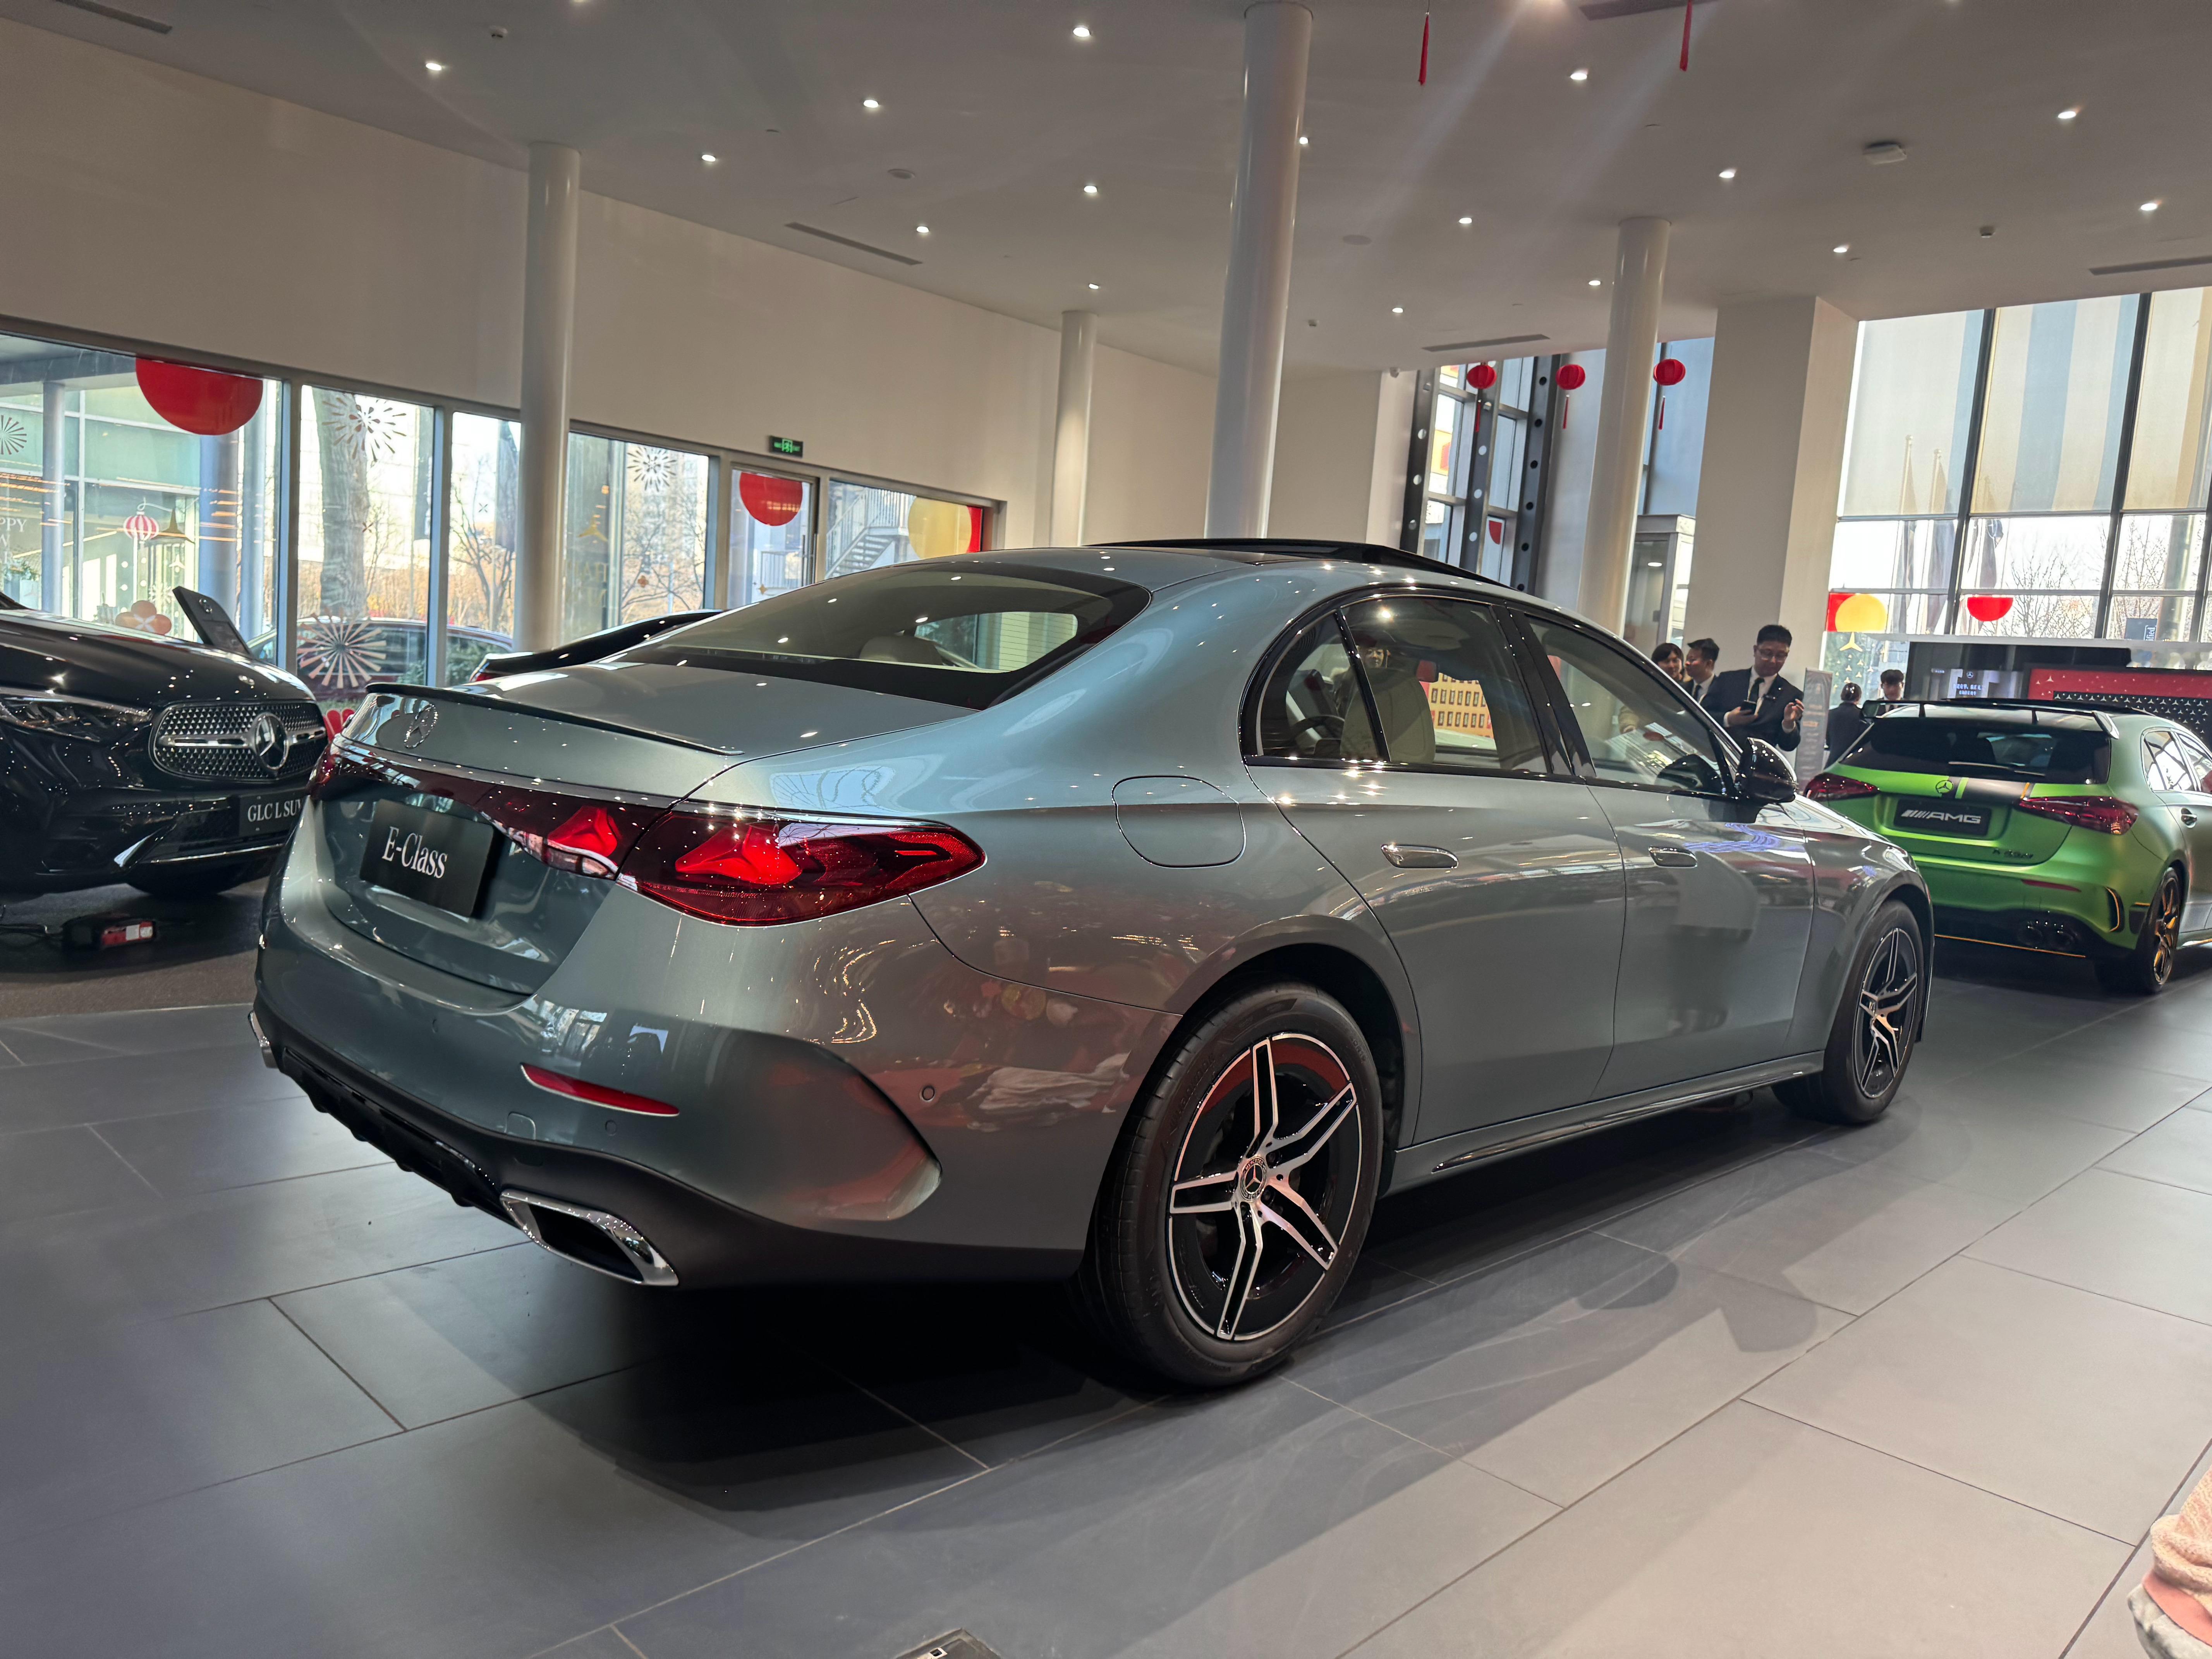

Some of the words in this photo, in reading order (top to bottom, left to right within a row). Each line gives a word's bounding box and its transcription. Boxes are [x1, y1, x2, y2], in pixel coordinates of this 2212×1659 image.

[248, 803, 273, 822] GLC
[275, 802, 282, 819] L
[1926, 812, 1981, 824] AMG
[382, 826, 447, 878] E-Class
